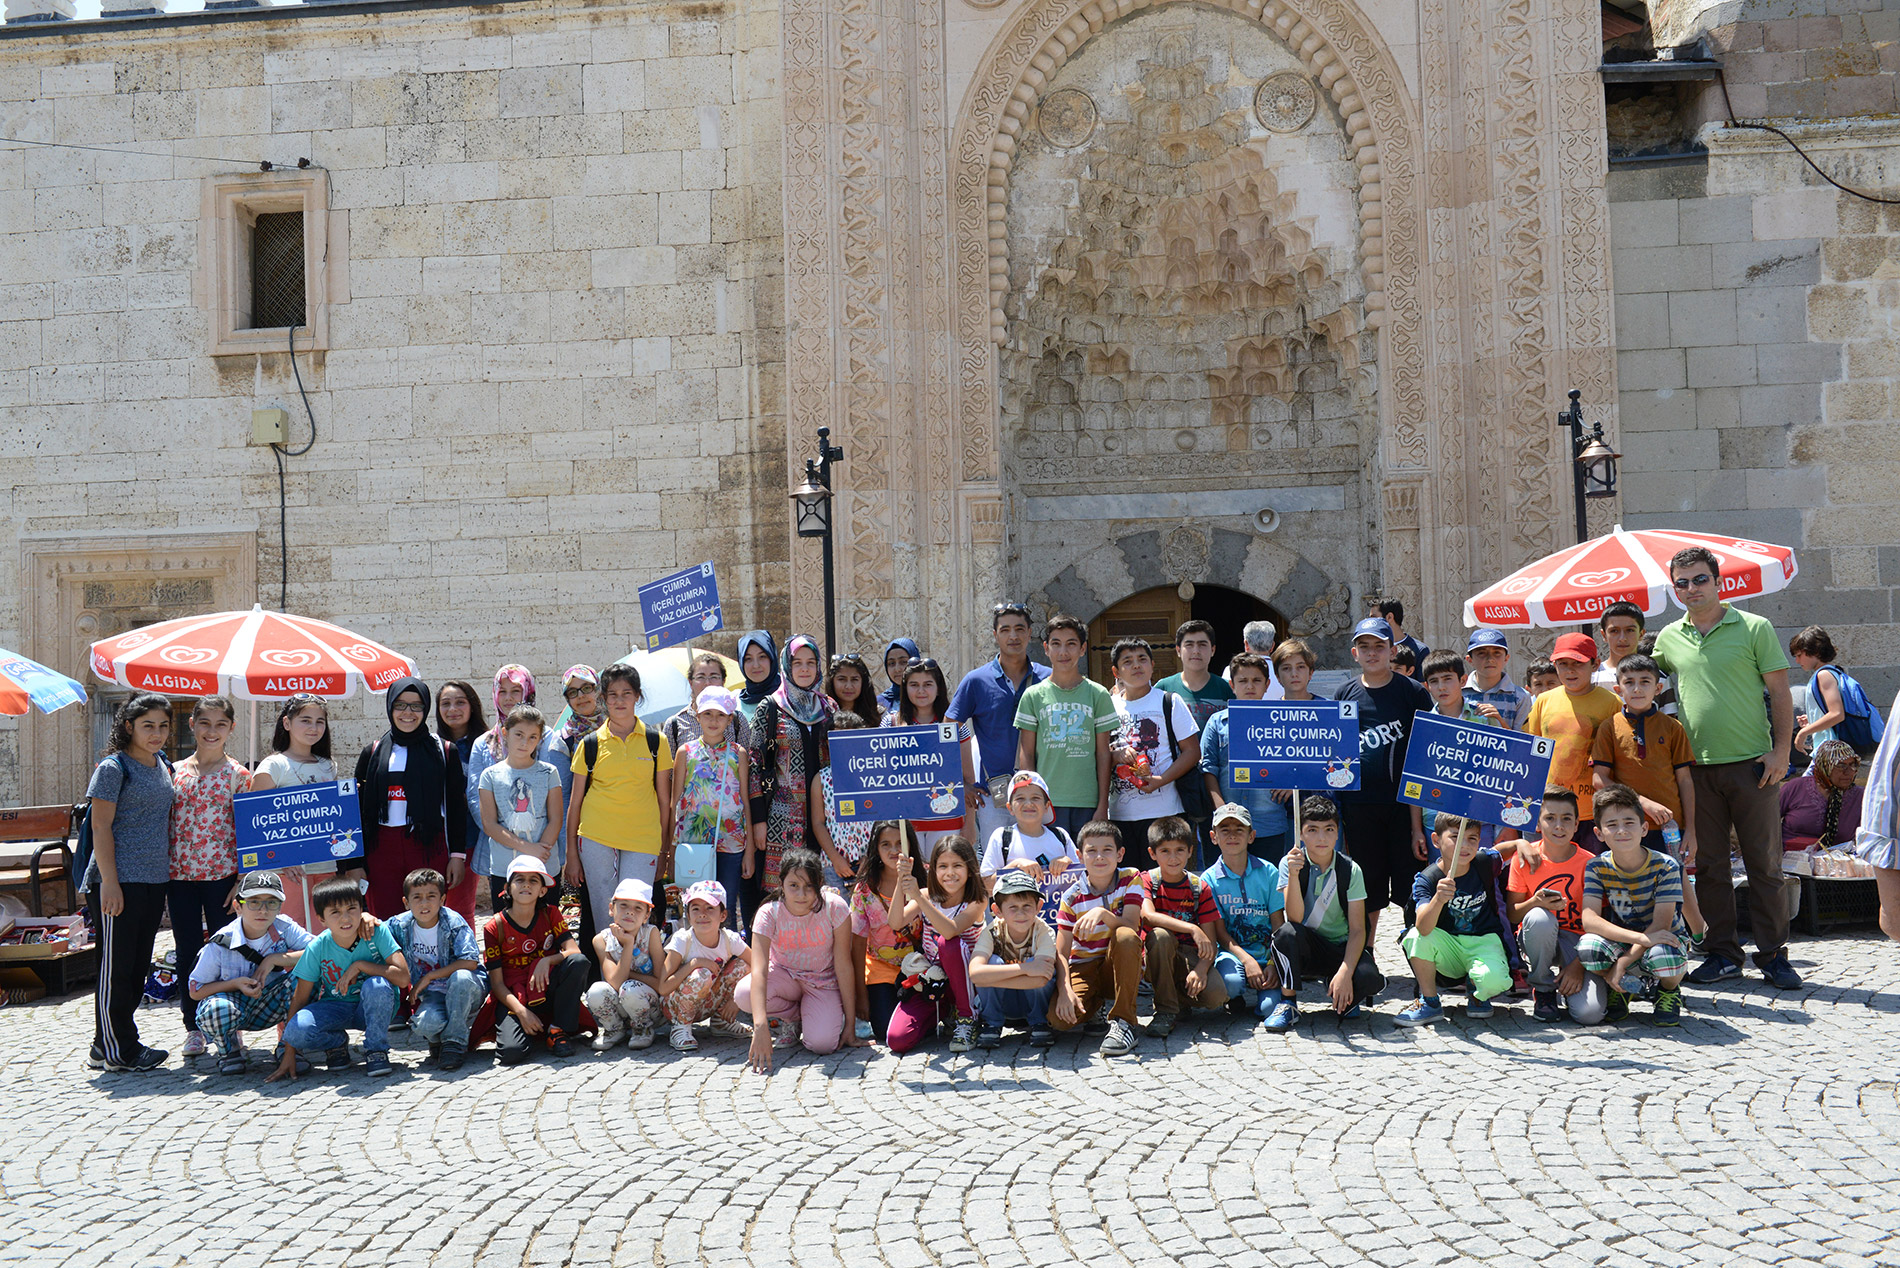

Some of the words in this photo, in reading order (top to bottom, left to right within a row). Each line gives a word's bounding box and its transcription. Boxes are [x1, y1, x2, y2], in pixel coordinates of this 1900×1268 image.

[704, 565, 710, 574] 3
[662, 577, 691, 596] ÇUMRA
[651, 595, 675, 614] (İÇERİ
[675, 585, 707, 605] ÇUMRA)
[659, 611, 675, 623] YAZ
[675, 601, 703, 618] OKULU
[1270, 710, 1319, 724] ÇUMRA
[1343, 704, 1352, 716] 2
[943, 727, 952, 739] 5
[1246, 725, 1286, 742] (İÇERİ
[1289, 728, 1342, 742] ÇUMRA)
[1456, 730, 1508, 752] ÇUMRA
[870, 736, 919, 753] ÇUMRA
[1257, 745, 1282, 757] YAZ
[1285, 746, 1332, 758] OKULU
[1536, 741, 1547, 754] 6
[848, 754, 887, 773] (İÇERİ
[890, 752, 944, 770] ÇUMRA)
[1427, 741, 1470, 763] (İÇERİ
[1472, 753, 1530, 779] ÇUMRA)
[860, 775, 885, 788] YAZ
[888, 772, 934, 786] OKULU
[1434, 763, 1462, 781] YAZ
[1464, 771, 1515, 793] OKULU
[342, 782, 350, 793] 4
[273, 792, 319, 809] ÇUMRA
[252, 810, 290, 829] (İÇERİ
[292, 804, 343, 823] ÇUMRA)
[263, 828, 288, 841] YAZ
[290, 822, 335, 837] OKULU
[777, 925, 826, 951] HELLO
